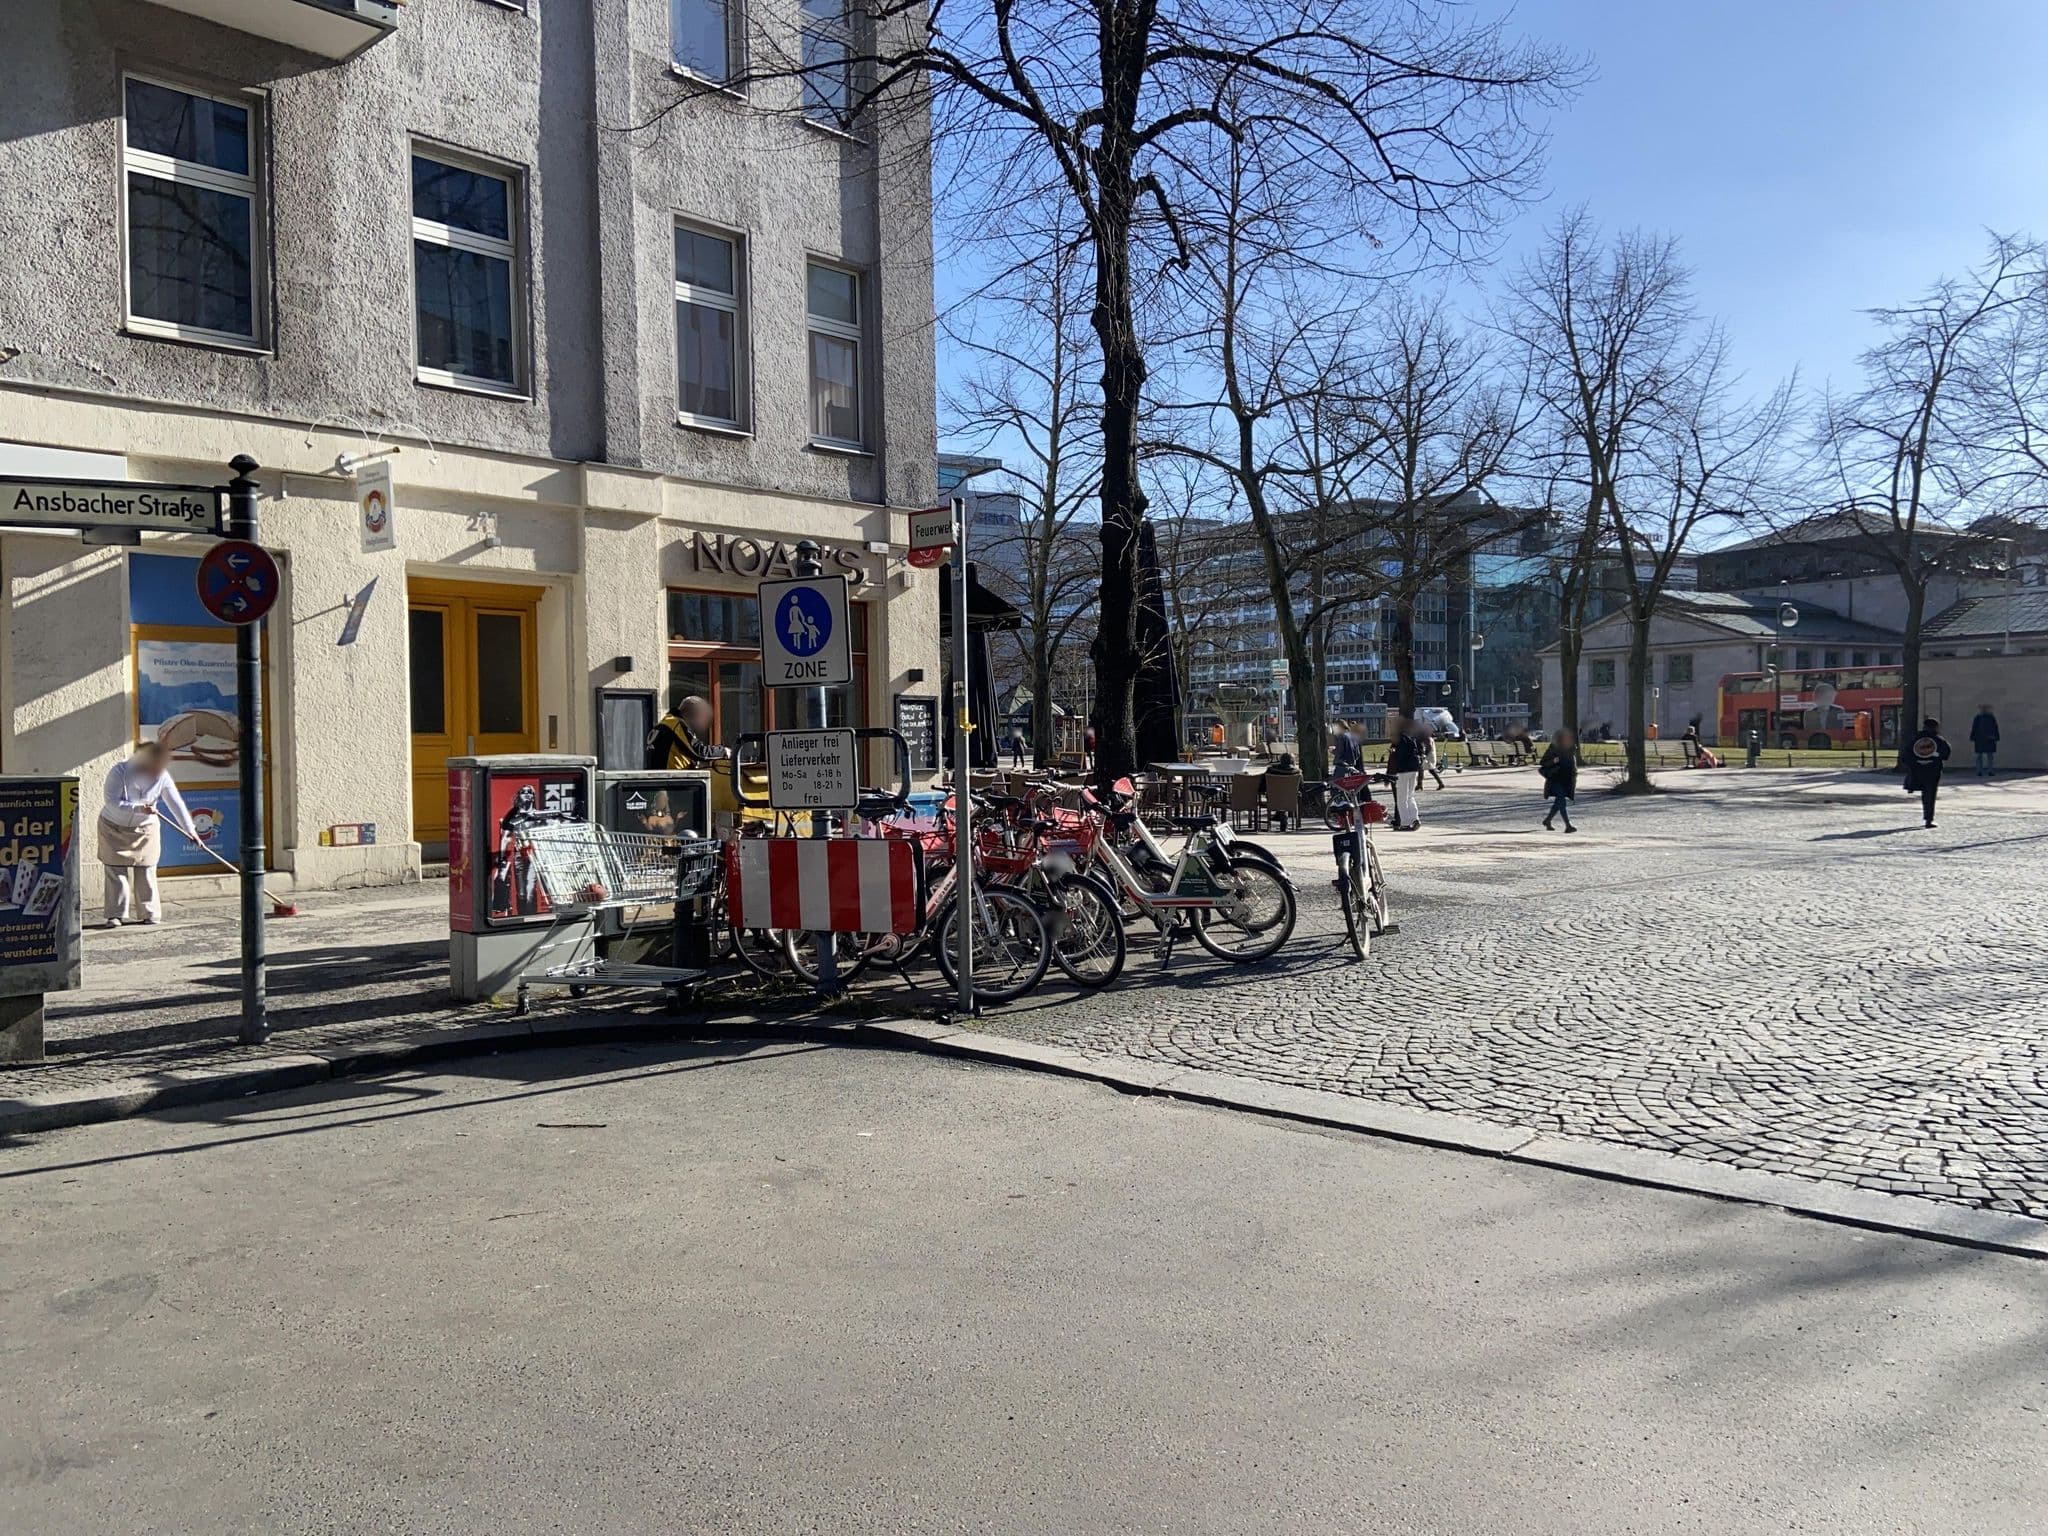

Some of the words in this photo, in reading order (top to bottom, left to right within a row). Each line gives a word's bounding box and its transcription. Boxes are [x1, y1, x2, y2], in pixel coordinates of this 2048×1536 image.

[13, 488, 135, 515] Ansbacher
[138, 494, 206, 522] Straße
[692, 532, 864, 585] NOA'S
[784, 661, 828, 679] ZONE
[781, 737, 819, 751] Anlieger
[823, 735, 840, 749] frei
[780, 752, 841, 767] Lieferverkehr
[781, 770, 808, 779] Mo-Sa
[816, 769, 834, 779] 6-18
[836, 768, 842, 778] h
[782, 781, 793, 791] Do
[813, 780, 834, 790] 18-21
[837, 779, 842, 789] h
[804, 793, 823, 804] frei
[13, 816, 55, 837] der
